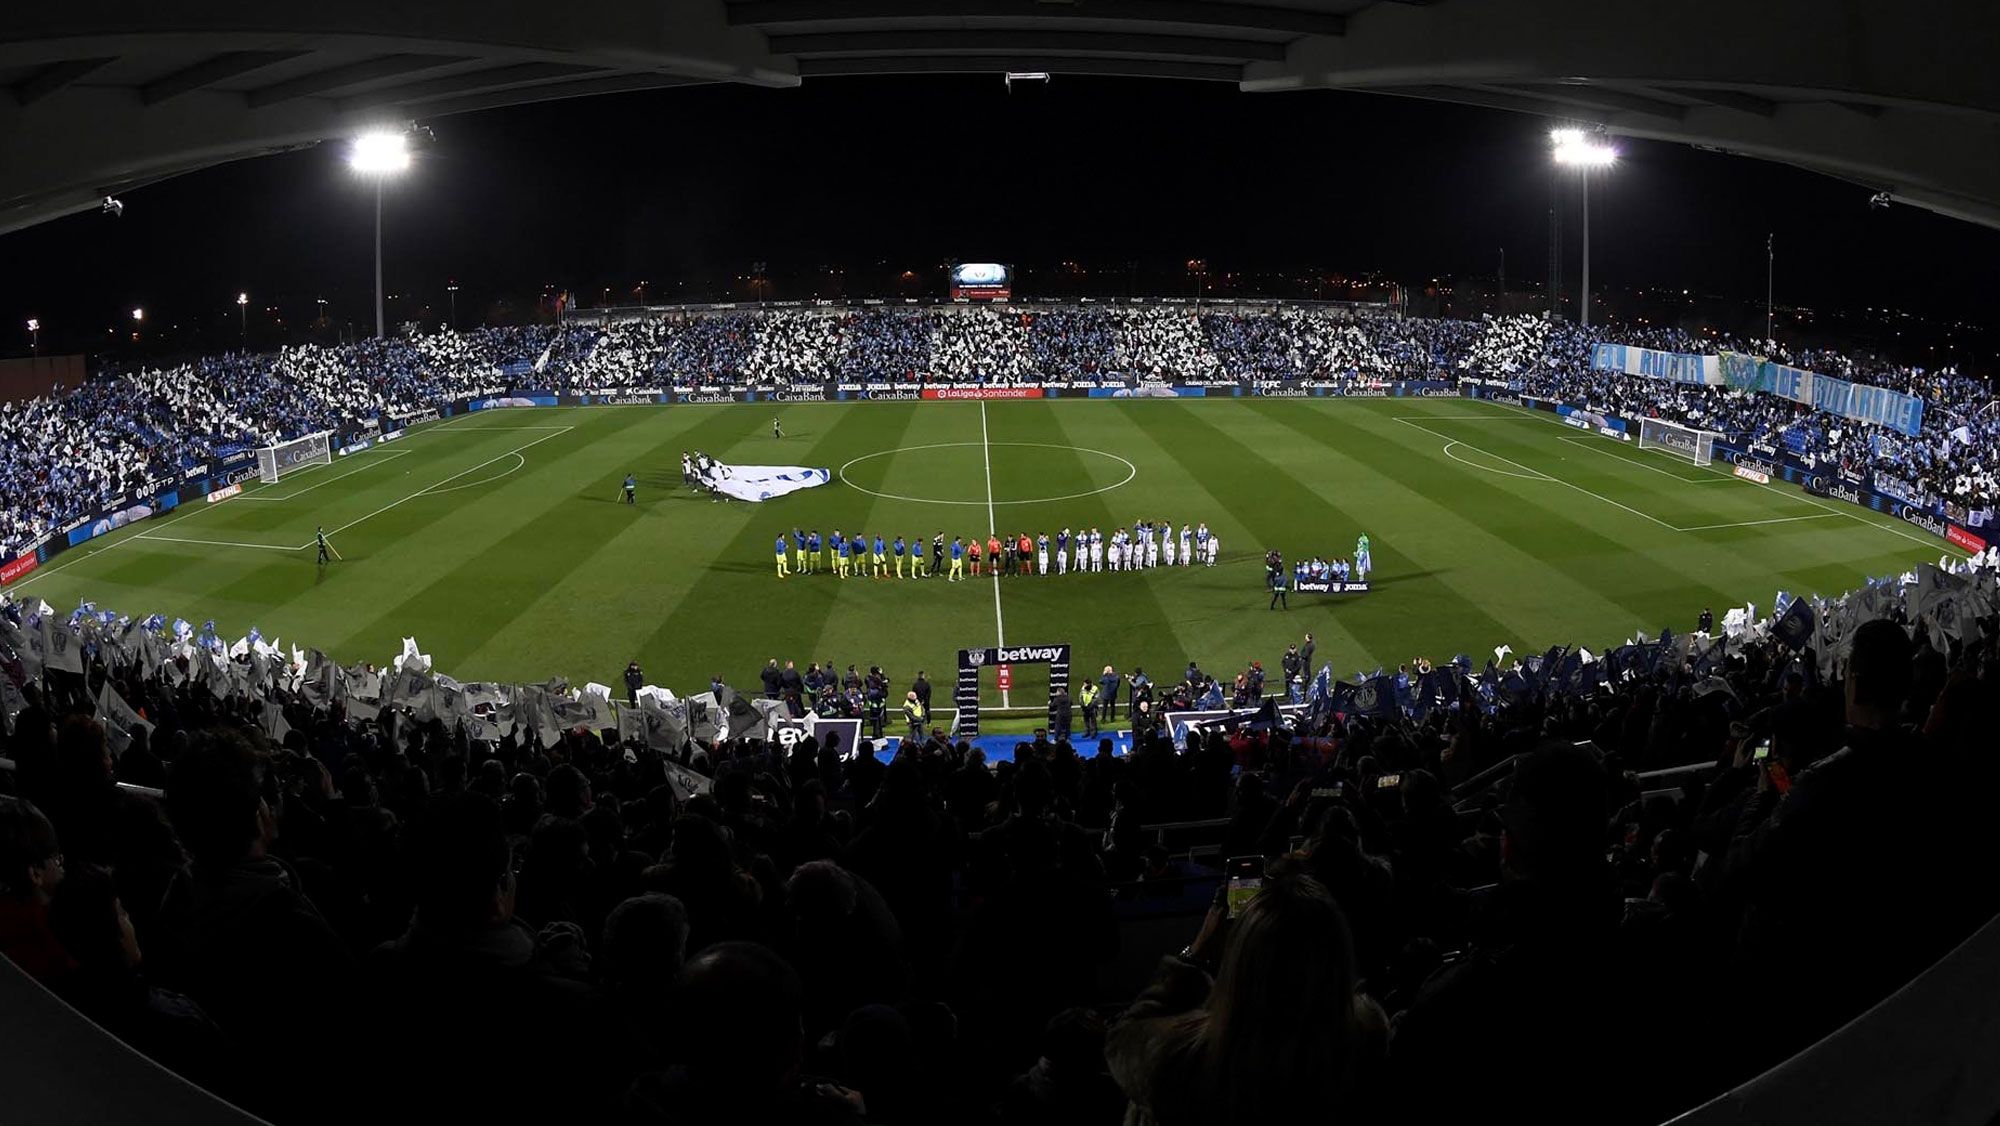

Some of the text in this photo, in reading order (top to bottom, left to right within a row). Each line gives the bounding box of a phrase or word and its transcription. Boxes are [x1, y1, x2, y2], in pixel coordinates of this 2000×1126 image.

[894, 382, 922, 390] betway
[923, 382, 951, 390] betway
[1485, 378, 1510, 388] betway
[775, 391, 826, 401] CaixaBank
[868, 390, 920, 400] CaixaBank
[982, 389, 1028, 397] Santander
[1262, 387, 1309, 396] CaixaBank
[1343, 387, 1388, 396] CaixaBank
[1421, 387, 1462, 396] CaixaBank
[606, 394, 653, 404] CaixaBank
[687, 393, 736, 402] CaixaBank
[1732, 452, 1775, 477] CaixaBank
[185, 464, 208, 479] betway
[1812, 476, 1860, 505] CxaBank
[1901, 505, 1946, 539] CaixaBank
[1299, 582, 1330, 592] betway
[997, 647, 1063, 663] betway
